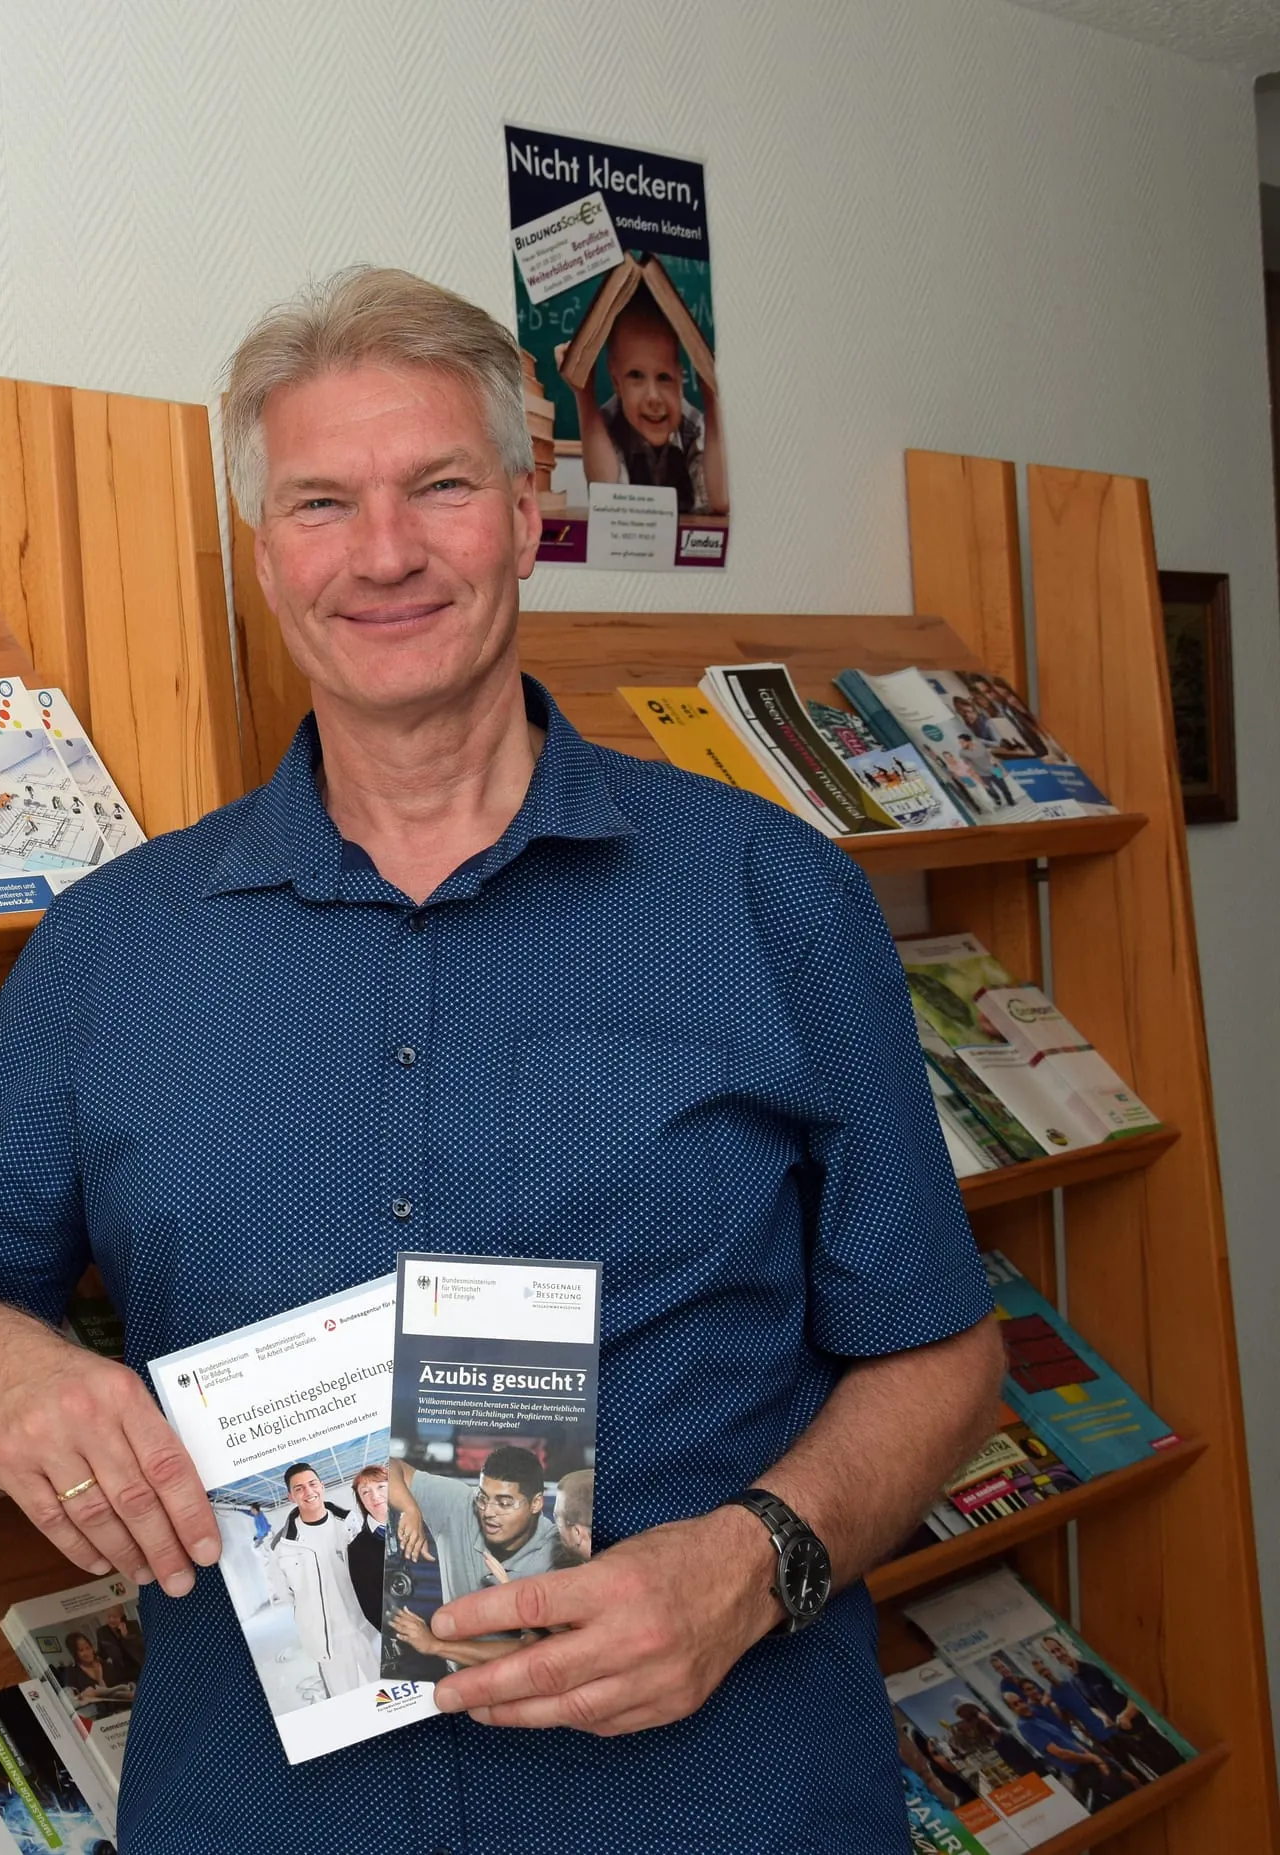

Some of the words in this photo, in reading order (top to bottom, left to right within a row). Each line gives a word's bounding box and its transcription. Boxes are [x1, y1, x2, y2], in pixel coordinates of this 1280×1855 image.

[510, 142, 580, 184] Nicht
[588, 155, 700, 211] kleckern,
[615, 216, 659, 233] sondern
[661, 222, 703, 240] klotzen!
[527, 256, 584, 287] Weiterbildung
[441, 1276, 497, 1286] Bundesministerium
[441, 1284, 450, 1292] für
[451, 1285, 481, 1293] Wirtschaft
[533, 1281, 582, 1291] PASSGENAUE
[453, 1293, 475, 1301] Energie
[536, 1290, 582, 1300] BESETZUNG
[339, 1304, 382, 1325] Bundesagentur
[255, 1331, 306, 1354] Bundesministerium
[266, 1346, 284, 1359] Arbeit
[284, 1344, 296, 1353] und
[296, 1336, 317, 1349] Soziales
[198, 1352, 250, 1374] Bundesministerium
[211, 1368, 232, 1380] Bildung
[215, 1371, 244, 1386] Forschung
[419, 1365, 488, 1387] Azubis
[218, 1359, 395, 1431] Berufseinstiegsbegleitung
[418, 1397, 484, 1408] Willkommenslotsen
[483, 1400, 510, 1410] beraten
[509, 1402, 520, 1410] Sie
[520, 1401, 531, 1411] bei
[530, 1402, 543, 1411] der
[542, 1403, 586, 1414] betrieblichen
[225, 1428, 248, 1449] die
[249, 1391, 358, 1440] Möglichmacher
[417, 1406, 457, 1417] Integration
[471, 1408, 516, 1420] Flüchtlingen.
[516, 1411, 553, 1421] Profitieren
[553, 1413, 564, 1422] Sie
[564, 1414, 579, 1422] von
[417, 1417, 447, 1426] unserem
[447, 1417, 489, 1428] kostenfreien
[489, 1419, 521, 1430] Angebot!
[232, 1446, 278, 1468] Informationen
[277, 1441, 287, 1452] für
[287, 1435, 309, 1448] Eltern,
[308, 1420, 347, 1441] Lehrerinnen
[346, 1416, 358, 1427] und
[358, 1410, 379, 1423] Lehrer
